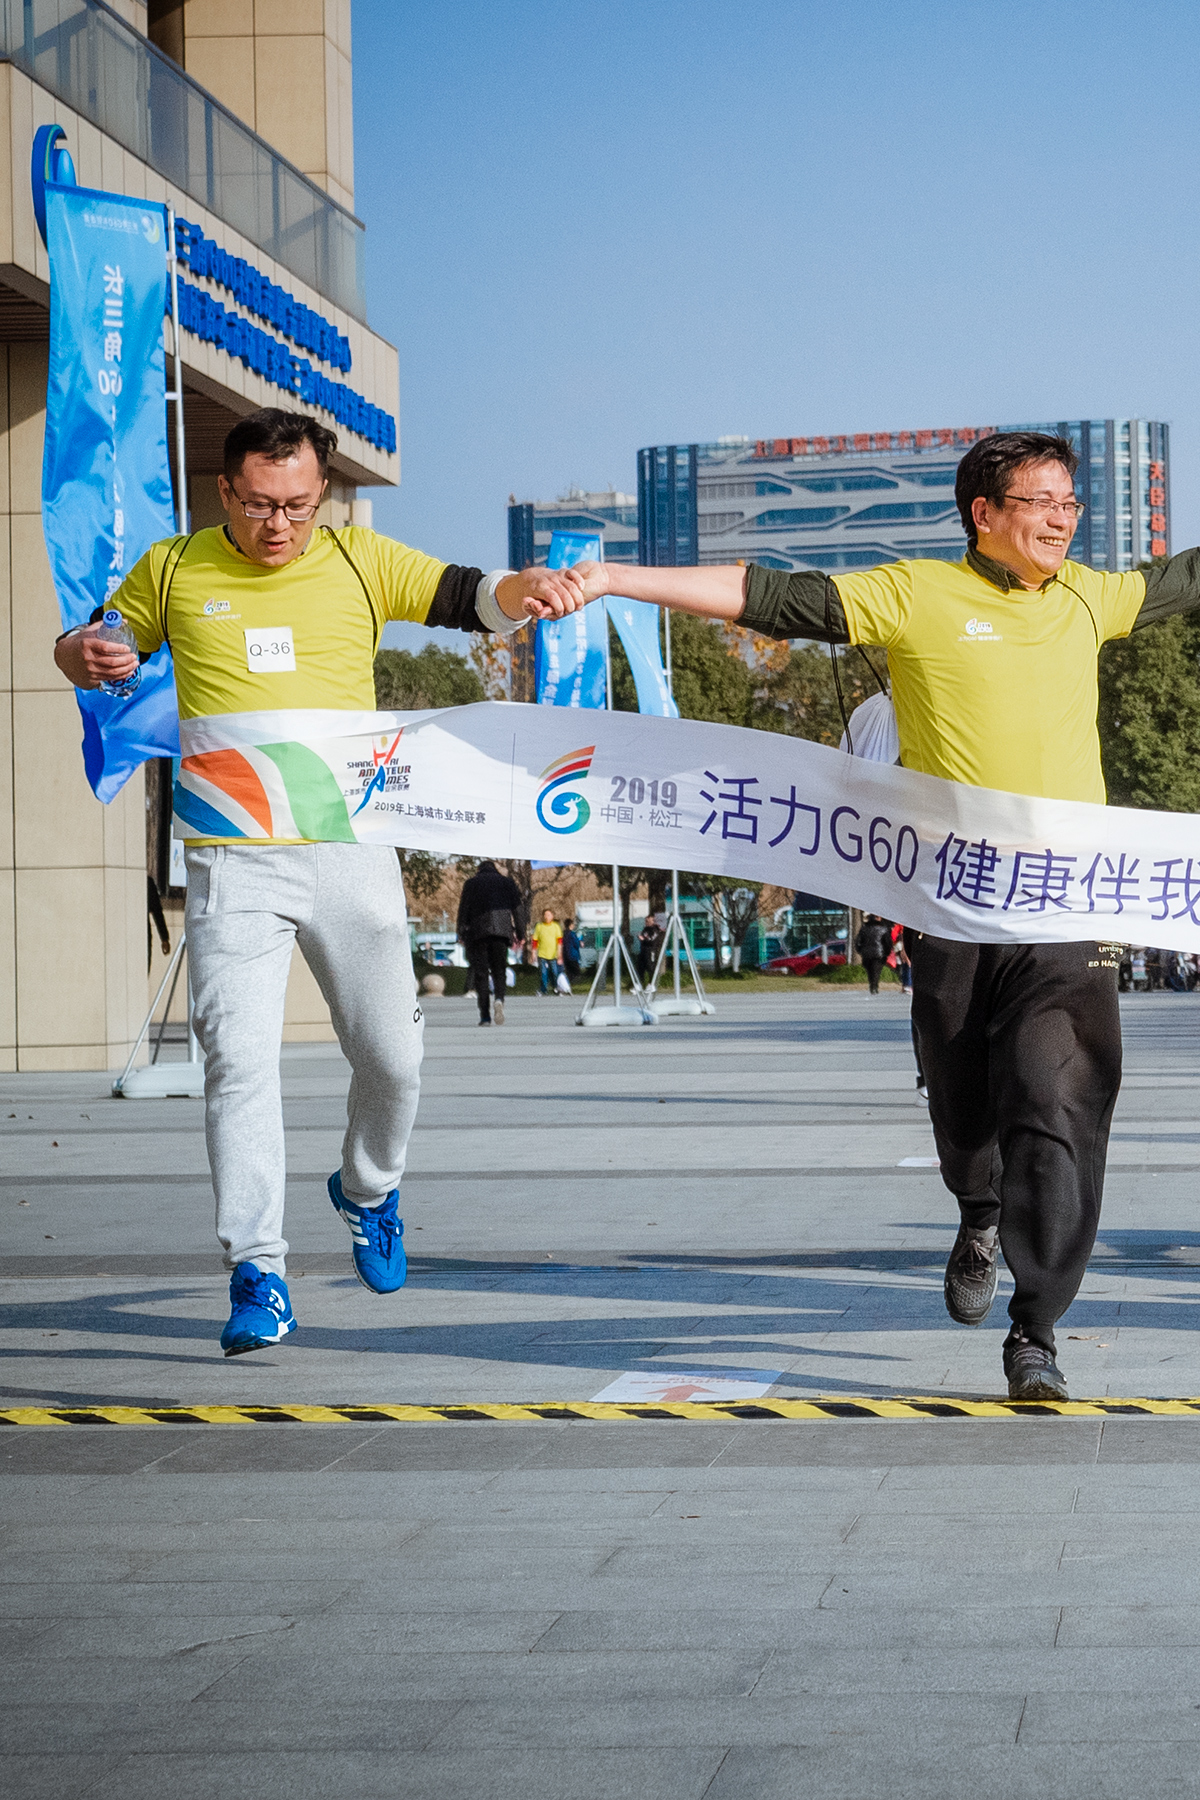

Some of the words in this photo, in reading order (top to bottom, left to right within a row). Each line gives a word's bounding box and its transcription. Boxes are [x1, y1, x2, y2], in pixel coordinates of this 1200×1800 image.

[249, 641, 291, 657] Q-36
[610, 775, 678, 808] 2019
[374, 801, 487, 825] 2019年上海城市业余联赛
[698, 770, 921, 883] 活力G60
